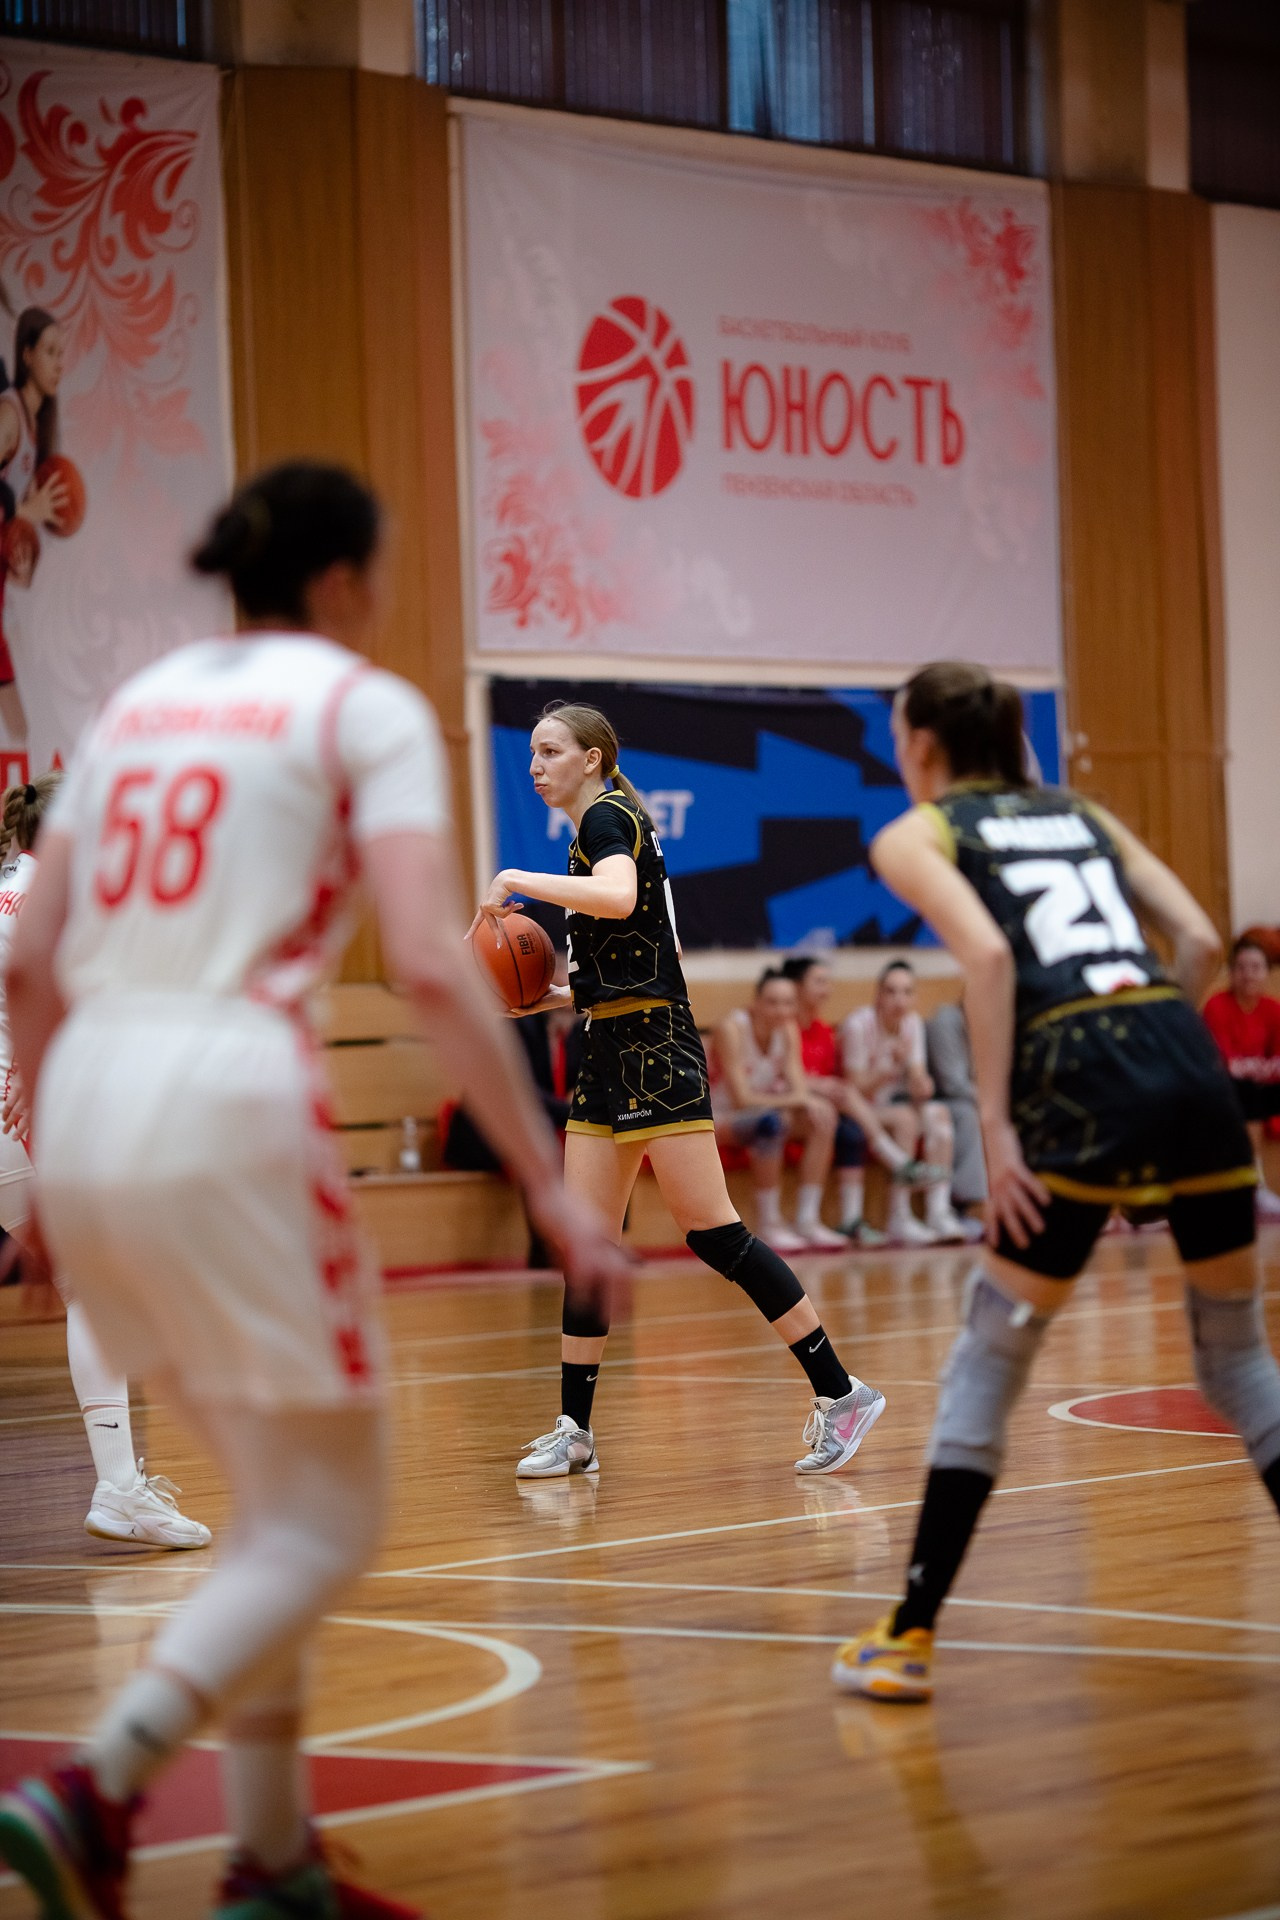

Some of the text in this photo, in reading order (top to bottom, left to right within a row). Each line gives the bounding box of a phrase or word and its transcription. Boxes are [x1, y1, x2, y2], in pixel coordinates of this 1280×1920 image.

[721, 360, 965, 467] ЮНОСТЬ
[94, 763, 227, 913] 58
[517, 934, 531, 956] FIBA
[1002, 856, 1147, 967] 21
[617, 1109, 653, 1121] ХИМПРОМ
